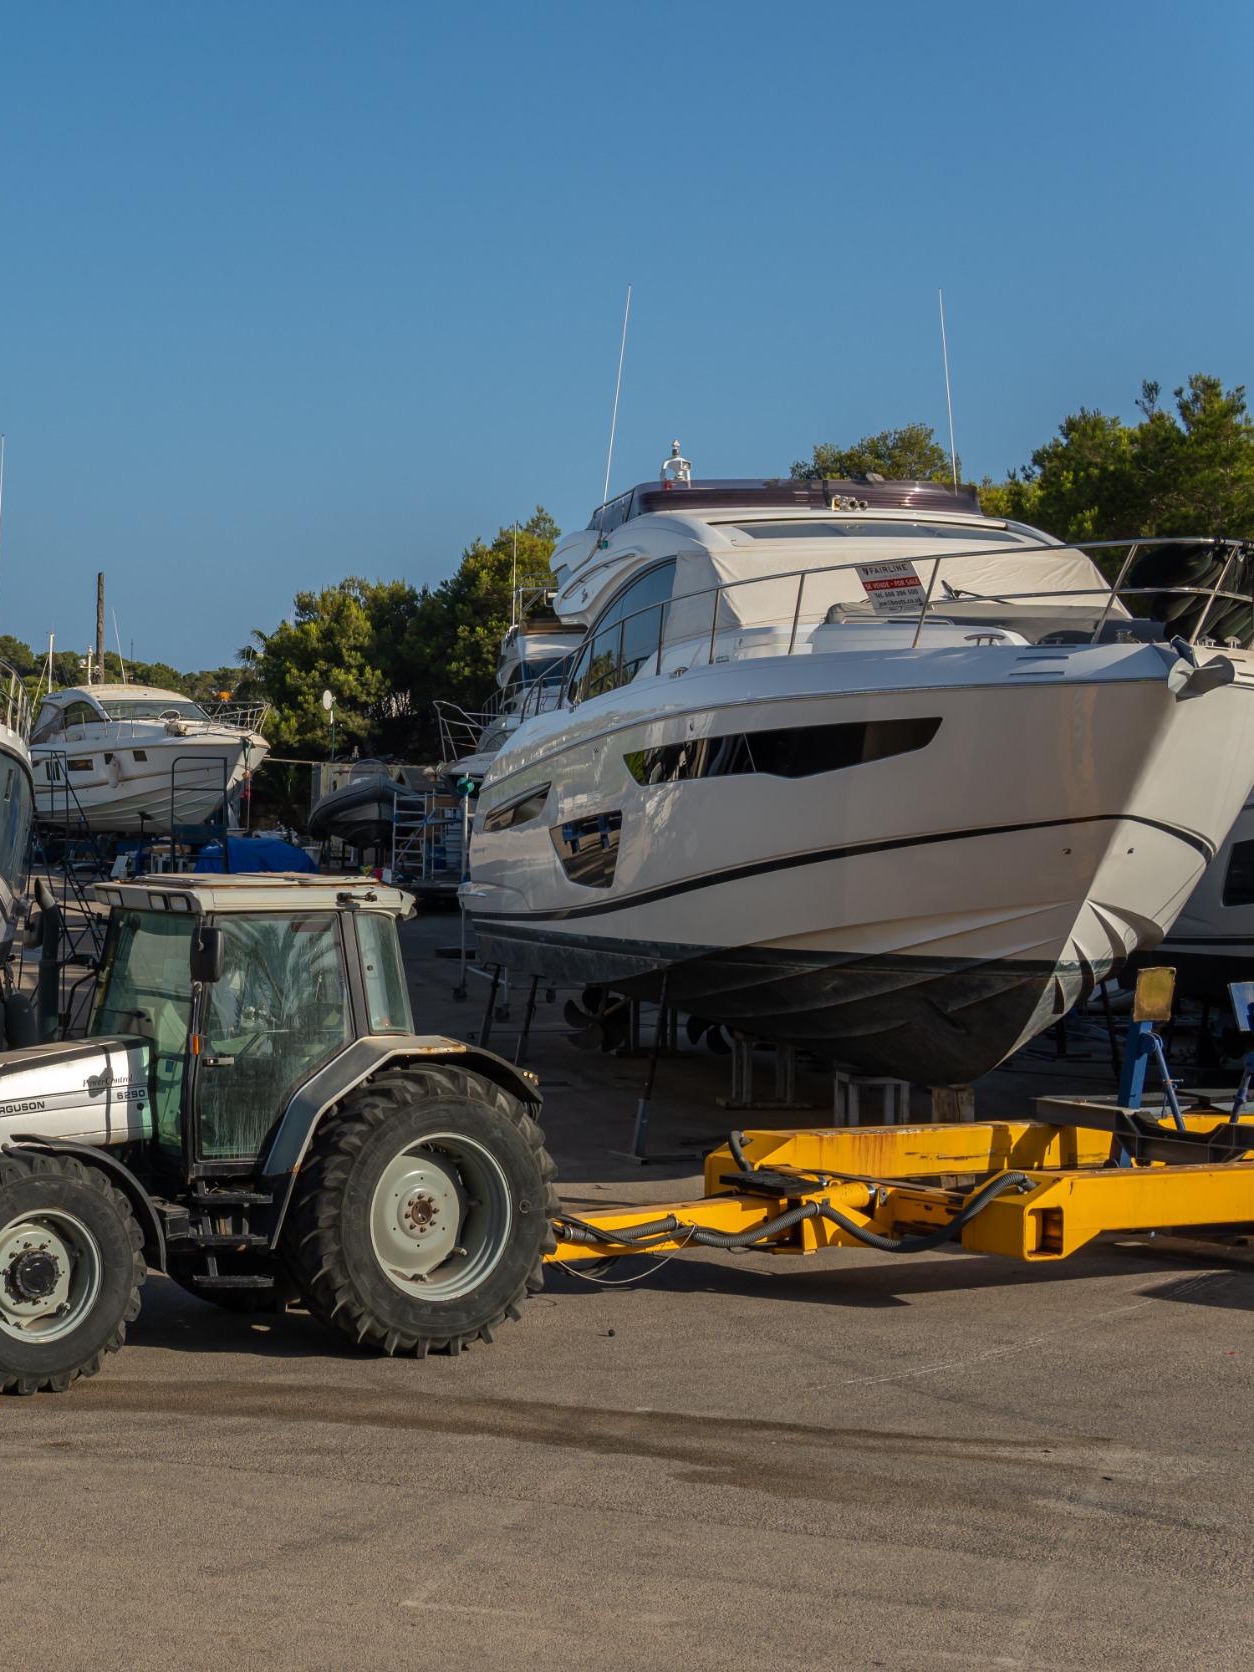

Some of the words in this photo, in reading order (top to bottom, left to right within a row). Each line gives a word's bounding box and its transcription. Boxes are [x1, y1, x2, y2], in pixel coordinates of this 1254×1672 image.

[870, 564, 908, 575] FAIRLINE
[873, 581, 890, 589] VENDE
[906, 578, 920, 586] SALE
[82, 1073, 134, 1088] PowerControl
[116, 1089, 146, 1100] 6290
